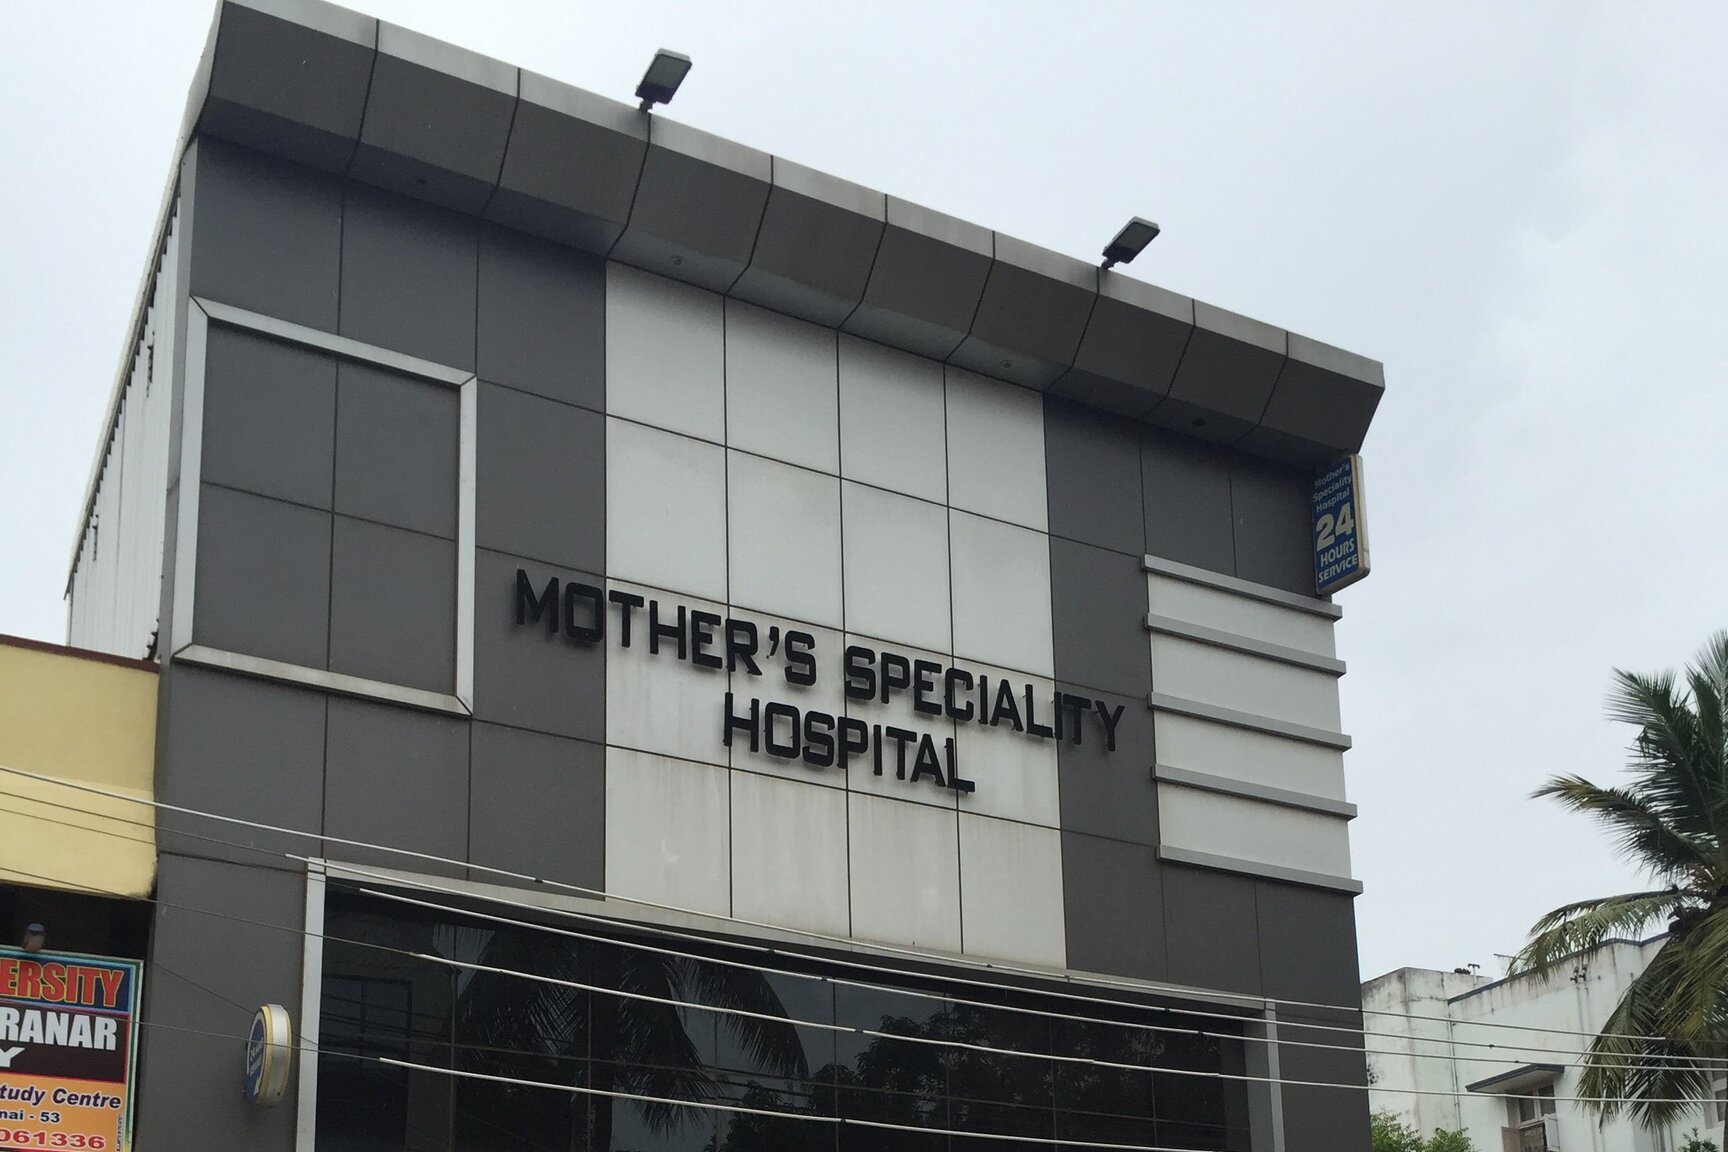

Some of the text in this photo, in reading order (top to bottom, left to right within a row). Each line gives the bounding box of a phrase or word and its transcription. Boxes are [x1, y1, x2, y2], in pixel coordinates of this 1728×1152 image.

[1312, 473, 1353, 503] Speciality
[1316, 487, 1350, 513] Hospital
[1315, 501, 1355, 552] 24
[1320, 537, 1355, 568] HOURS
[1318, 553, 1359, 583] SERVICE
[516, 567, 1125, 752] MOTHER'S SPECIALITY
[723, 691, 975, 793] HOSPITAL
[52, 1087, 122, 1109] Centre
[39, 1111, 61, 1123] 53
